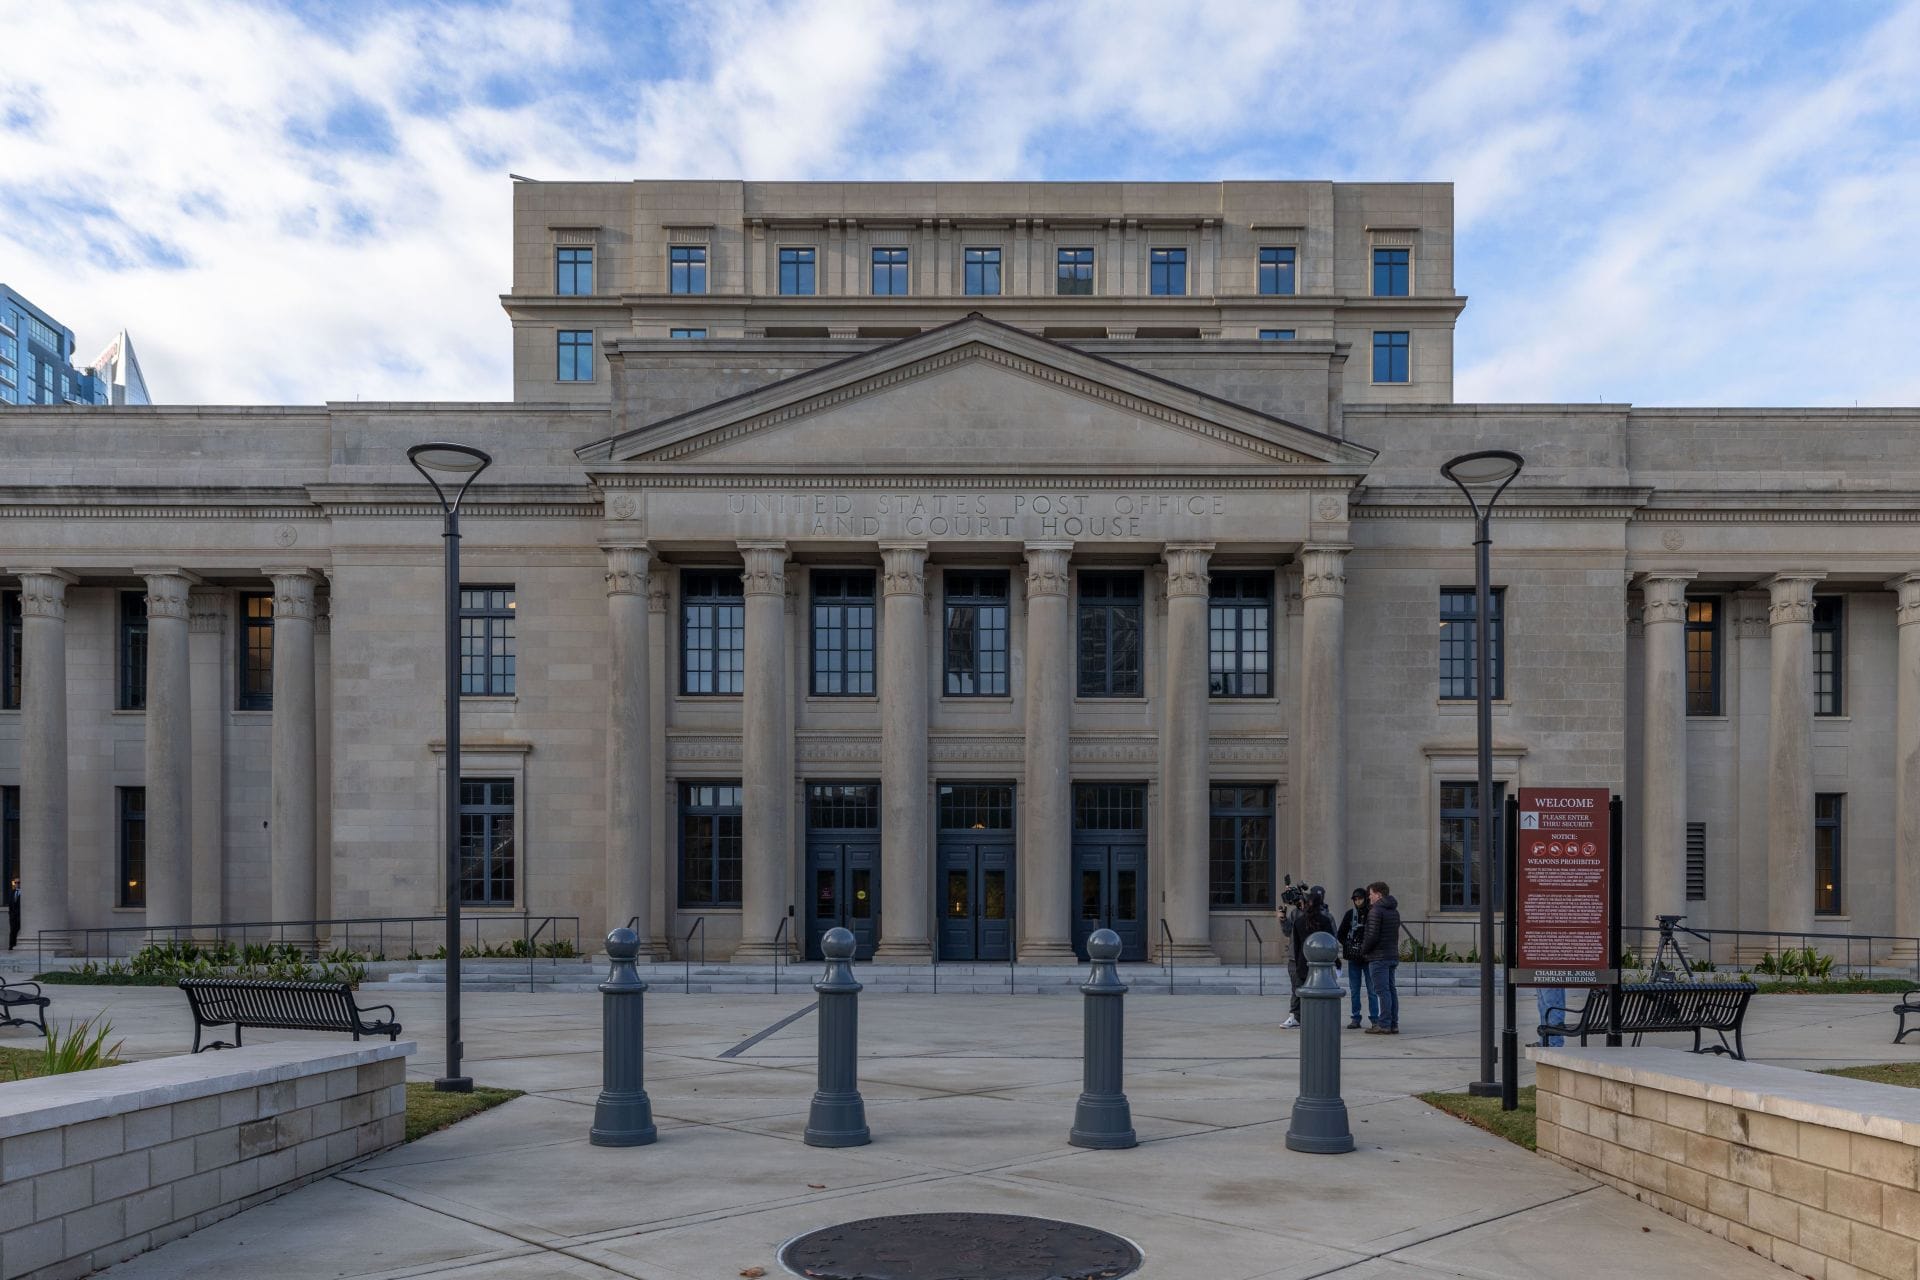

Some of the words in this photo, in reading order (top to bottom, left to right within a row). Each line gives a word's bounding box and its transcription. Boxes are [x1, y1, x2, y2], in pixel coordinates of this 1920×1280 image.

[728, 495, 852, 514] UNITED
[878, 495, 987, 514] STATES
[1014, 495, 1089, 515] POST
[1114, 495, 1224, 515] OFFICE
[812, 516, 880, 536] AND
[906, 516, 1015, 536] COURT
[1041, 516, 1141, 537] HOUSE
[1535, 798, 1594, 808] WELCOME
